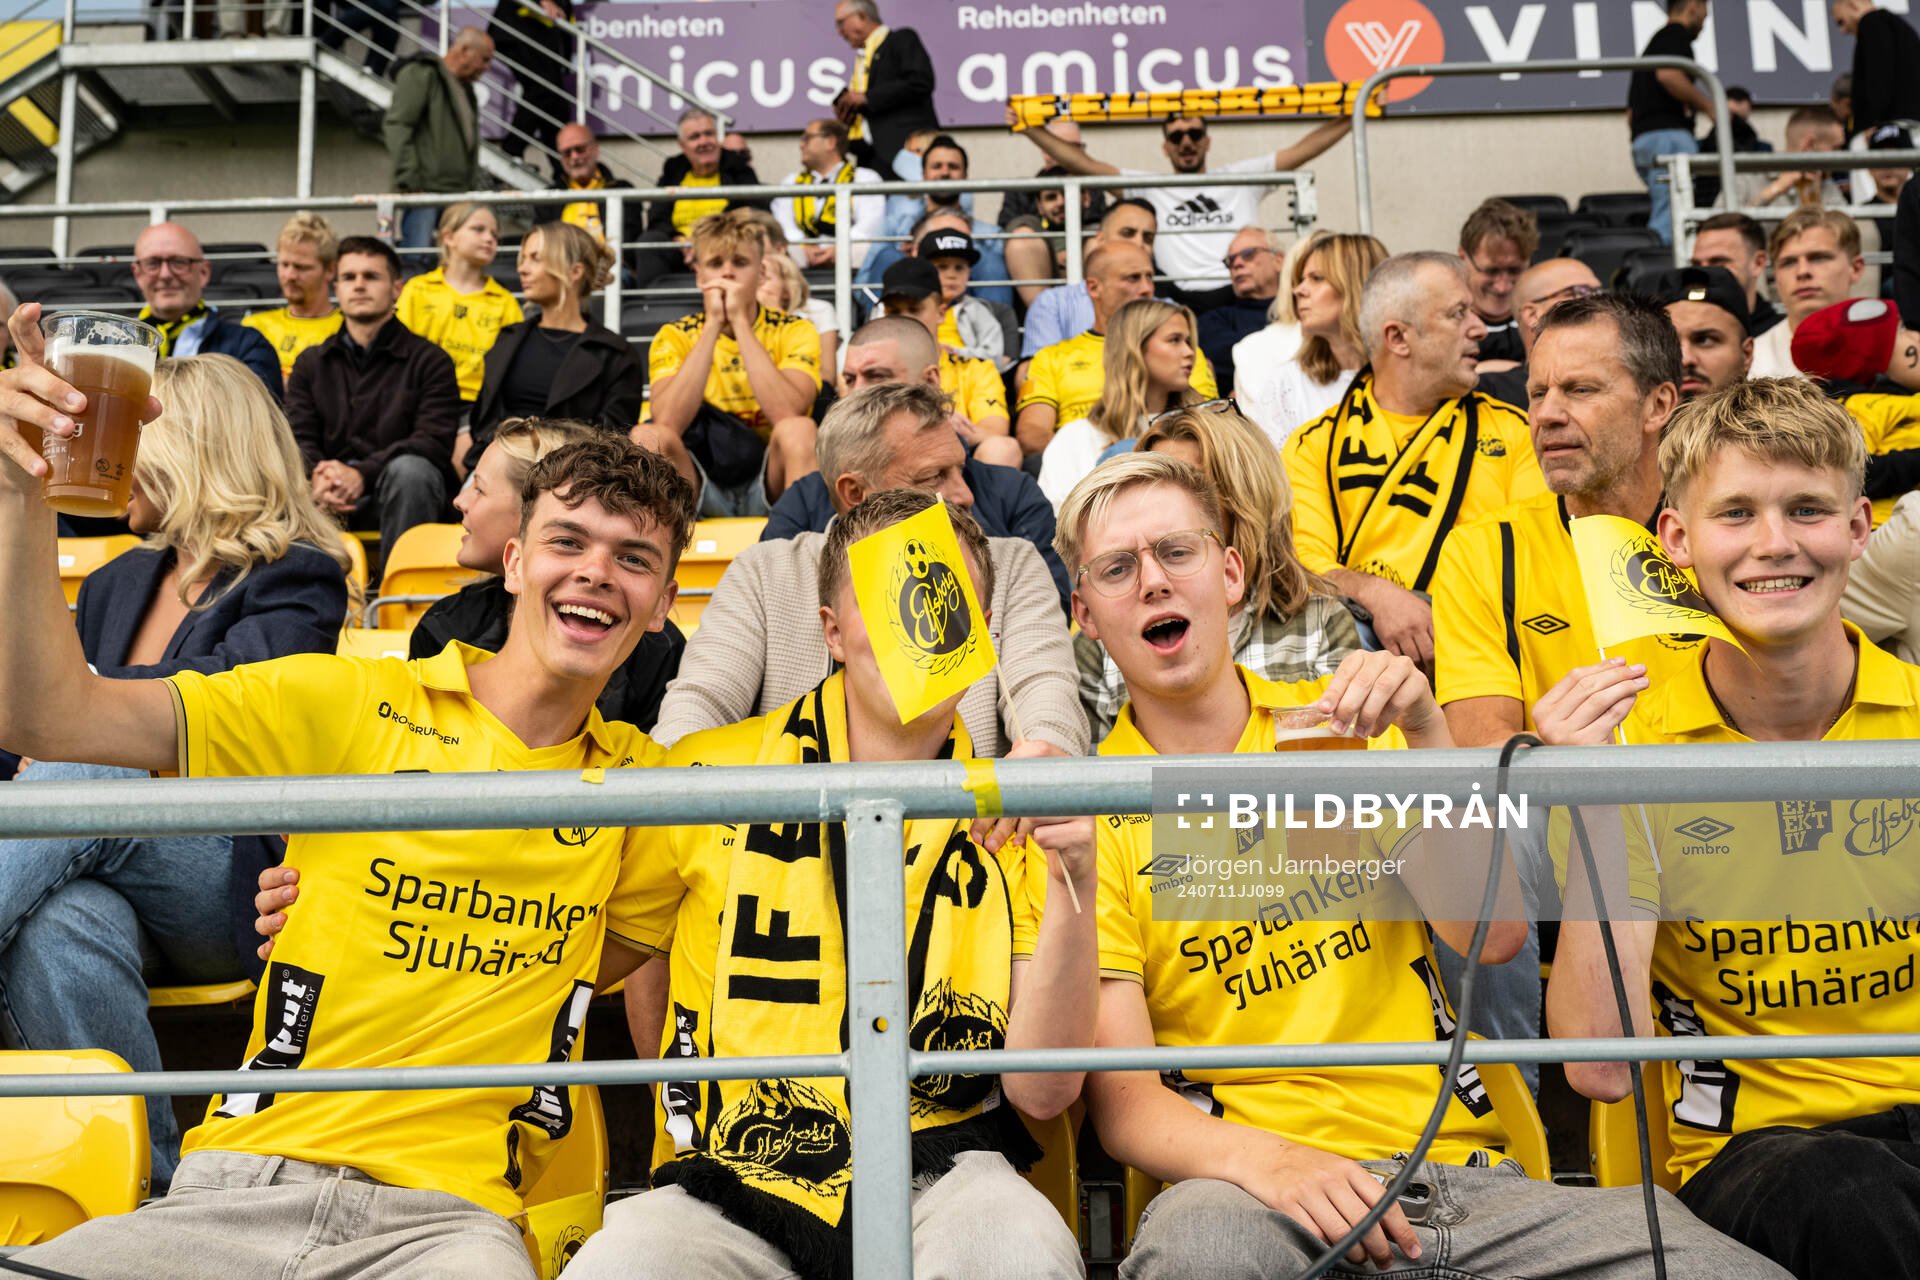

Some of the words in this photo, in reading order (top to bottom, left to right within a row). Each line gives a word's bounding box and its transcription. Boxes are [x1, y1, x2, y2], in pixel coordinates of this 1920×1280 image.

[576, 14, 724, 39] benheten
[958, 3, 1166, 31] Rehabenheten
[1465, 0, 1909, 80] VINN
[587, 45, 848, 112] micus
[957, 33, 1295, 102] amicus
[909, 570, 960, 649] Elfsborg
[1682, 844, 1730, 856] umbro
[1150, 873, 1194, 894] umbro
[728, 894, 821, 1005] IF
[1718, 953, 1914, 1016] Sjuhärad
